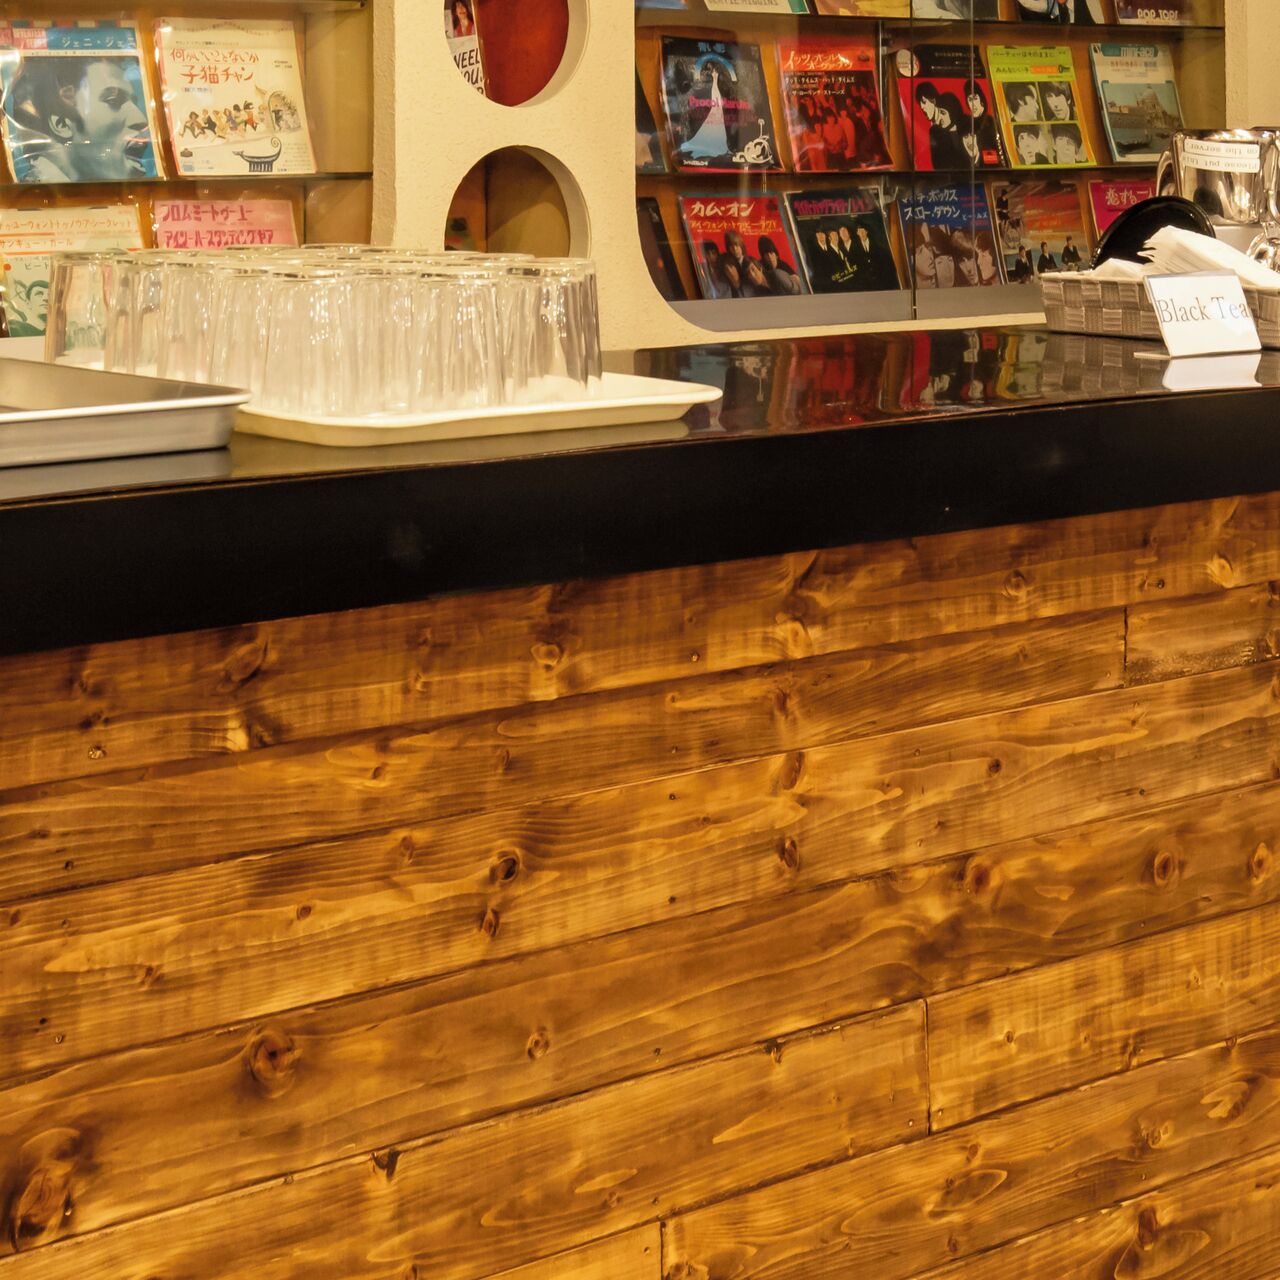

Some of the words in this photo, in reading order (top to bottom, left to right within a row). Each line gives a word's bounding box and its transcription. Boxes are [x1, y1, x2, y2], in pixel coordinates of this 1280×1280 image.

[180, 64, 255, 85] 子猫チャン
[690, 200, 756, 218] カム・オン
[1157, 296, 1212, 323] Black
[1210, 296, 1251, 321] Tea
